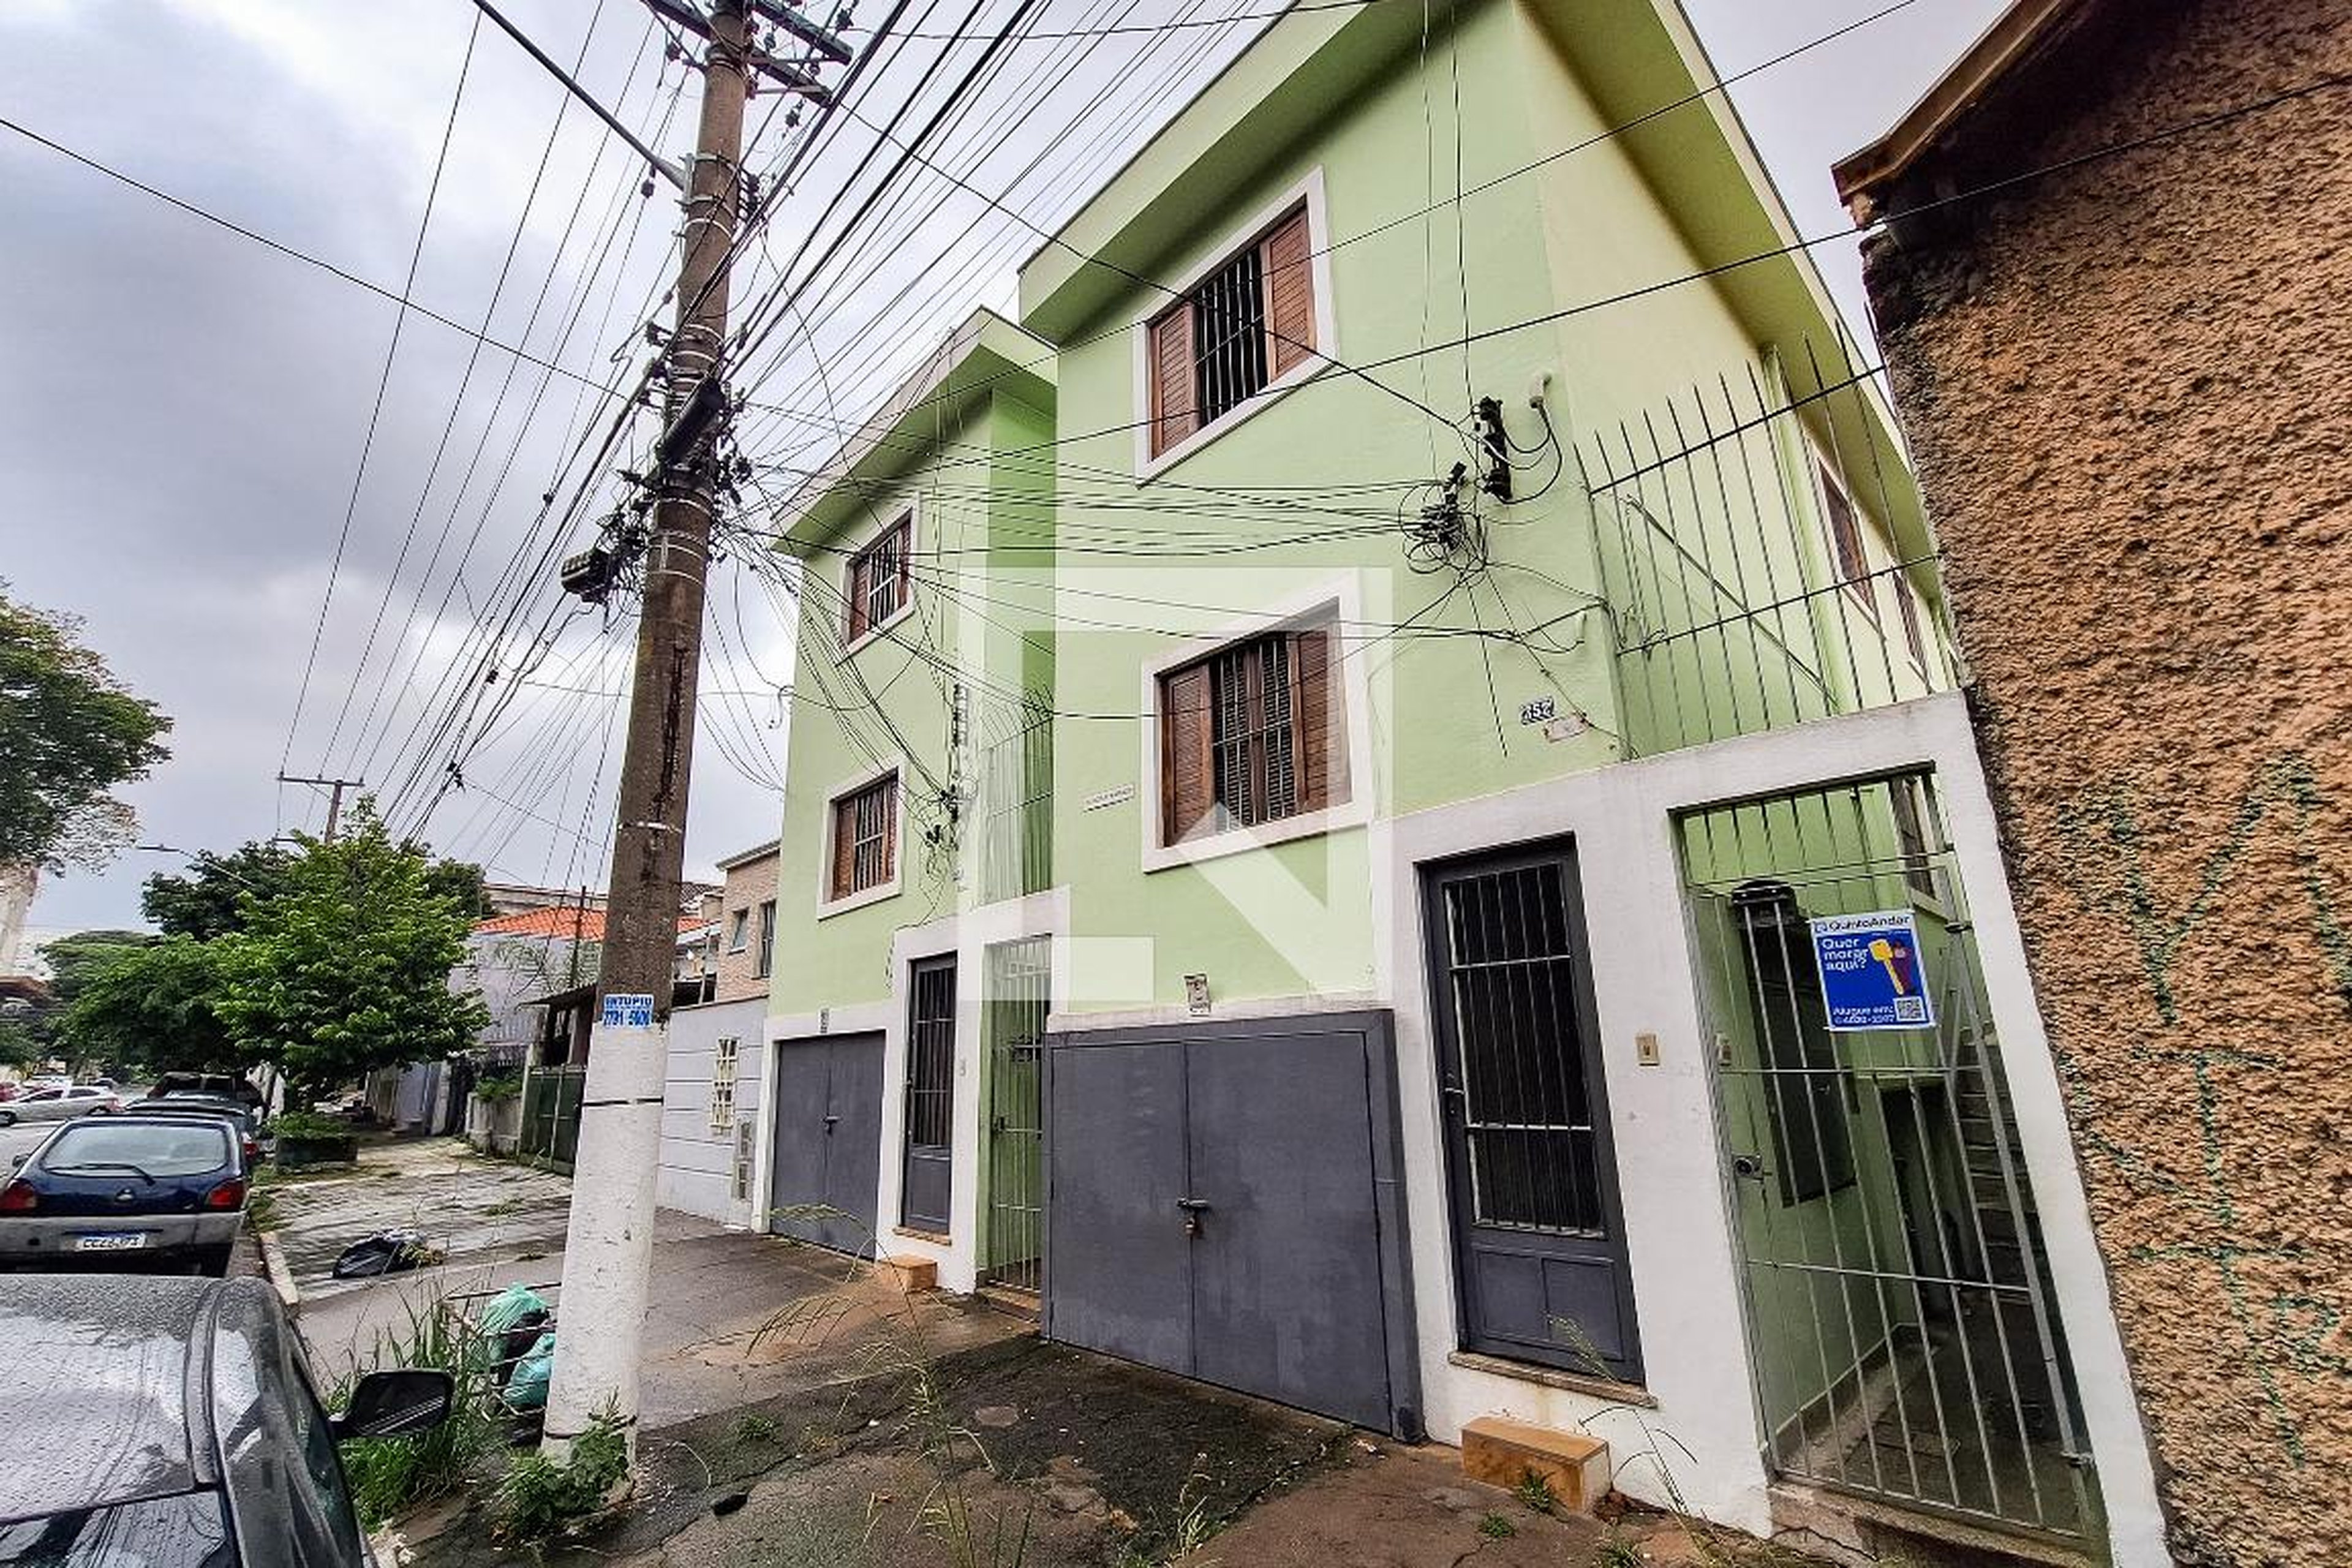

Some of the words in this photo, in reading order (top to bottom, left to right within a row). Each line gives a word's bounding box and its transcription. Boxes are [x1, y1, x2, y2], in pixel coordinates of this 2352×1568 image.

[1822, 938, 1860, 949] Quer
[1824, 949, 1868, 960] morar
[1826, 957, 1867, 972] aqui?
